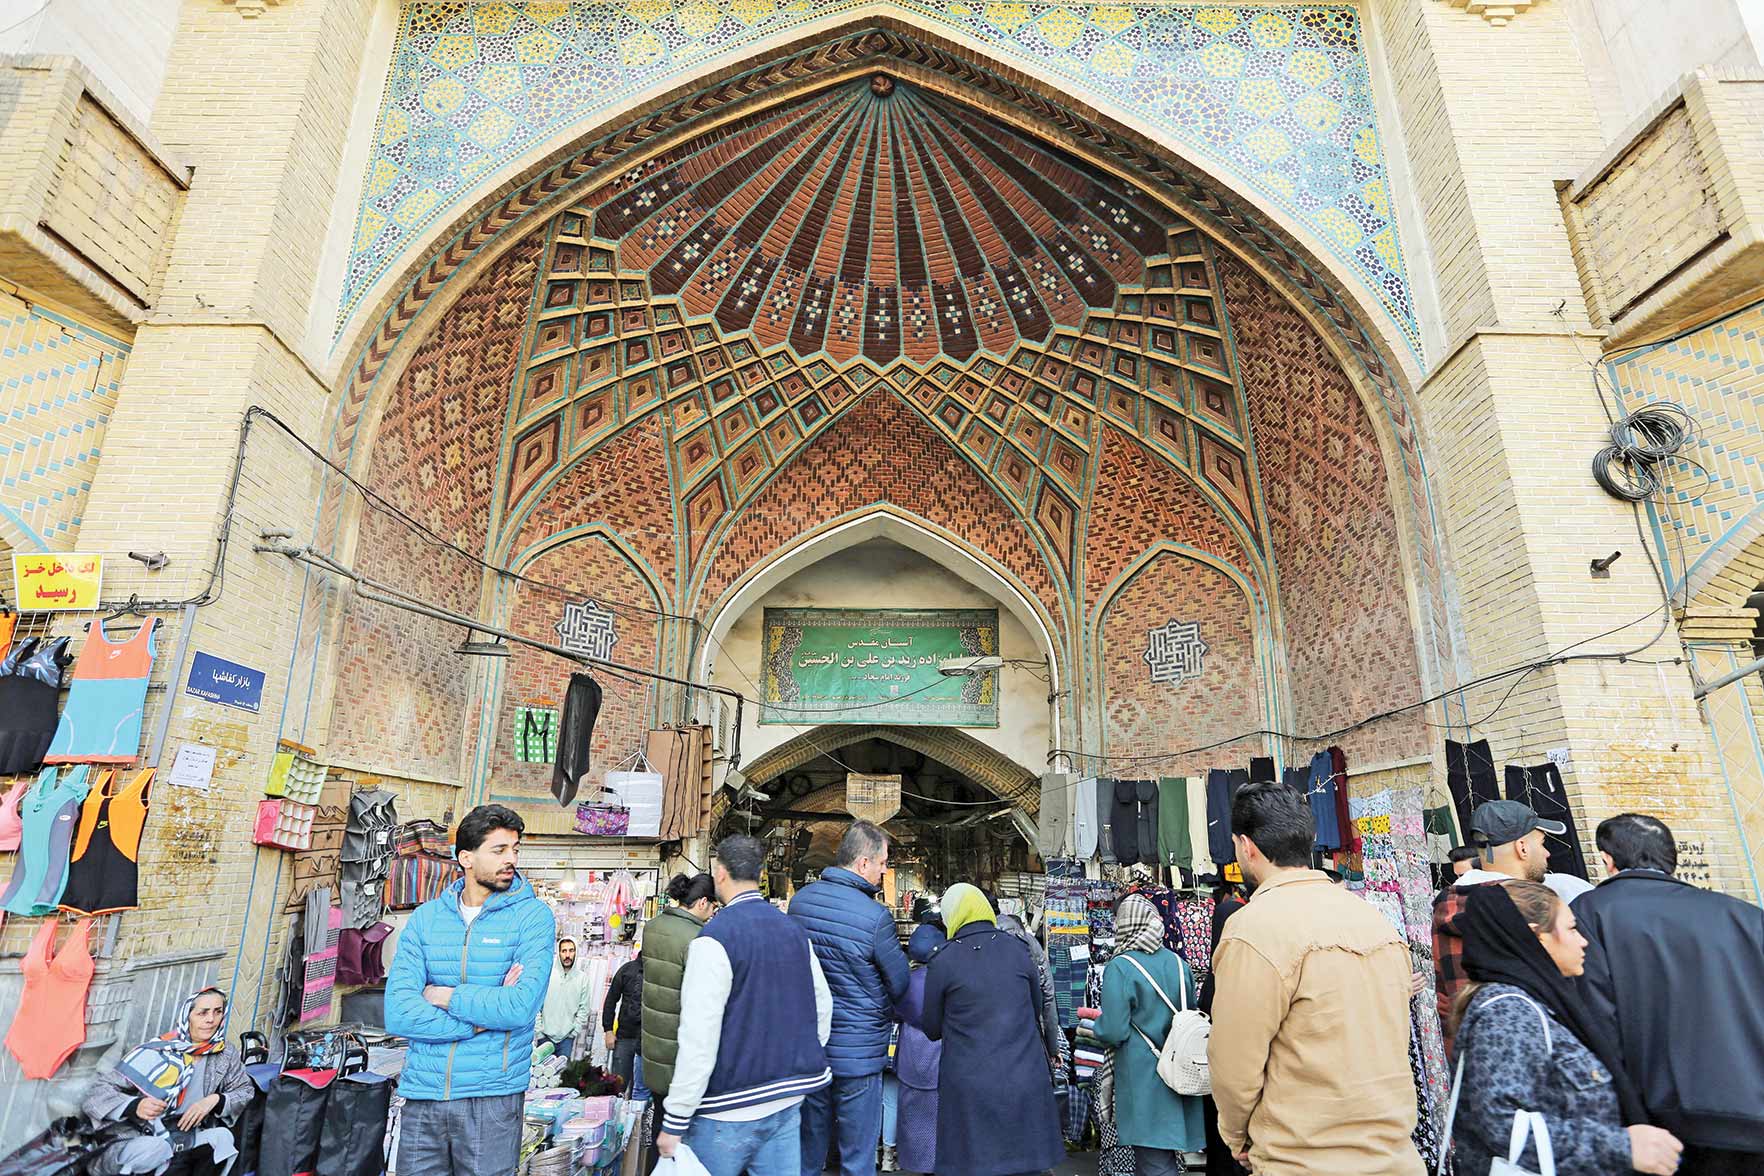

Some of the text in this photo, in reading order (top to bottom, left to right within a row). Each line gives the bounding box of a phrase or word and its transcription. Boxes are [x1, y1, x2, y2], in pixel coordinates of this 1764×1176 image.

[23, 562, 46, 577] خز
[35, 584, 77, 603] رسید
[847, 636, 913, 649] آستان مقدس
[798, 651, 839, 668] الحسین
[840, 655, 855, 668] بن
[856, 652, 880, 667] علی
[880, 655, 896, 668] بن
[897, 654, 917, 669] زید
[234, 675, 251, 690] بازار
